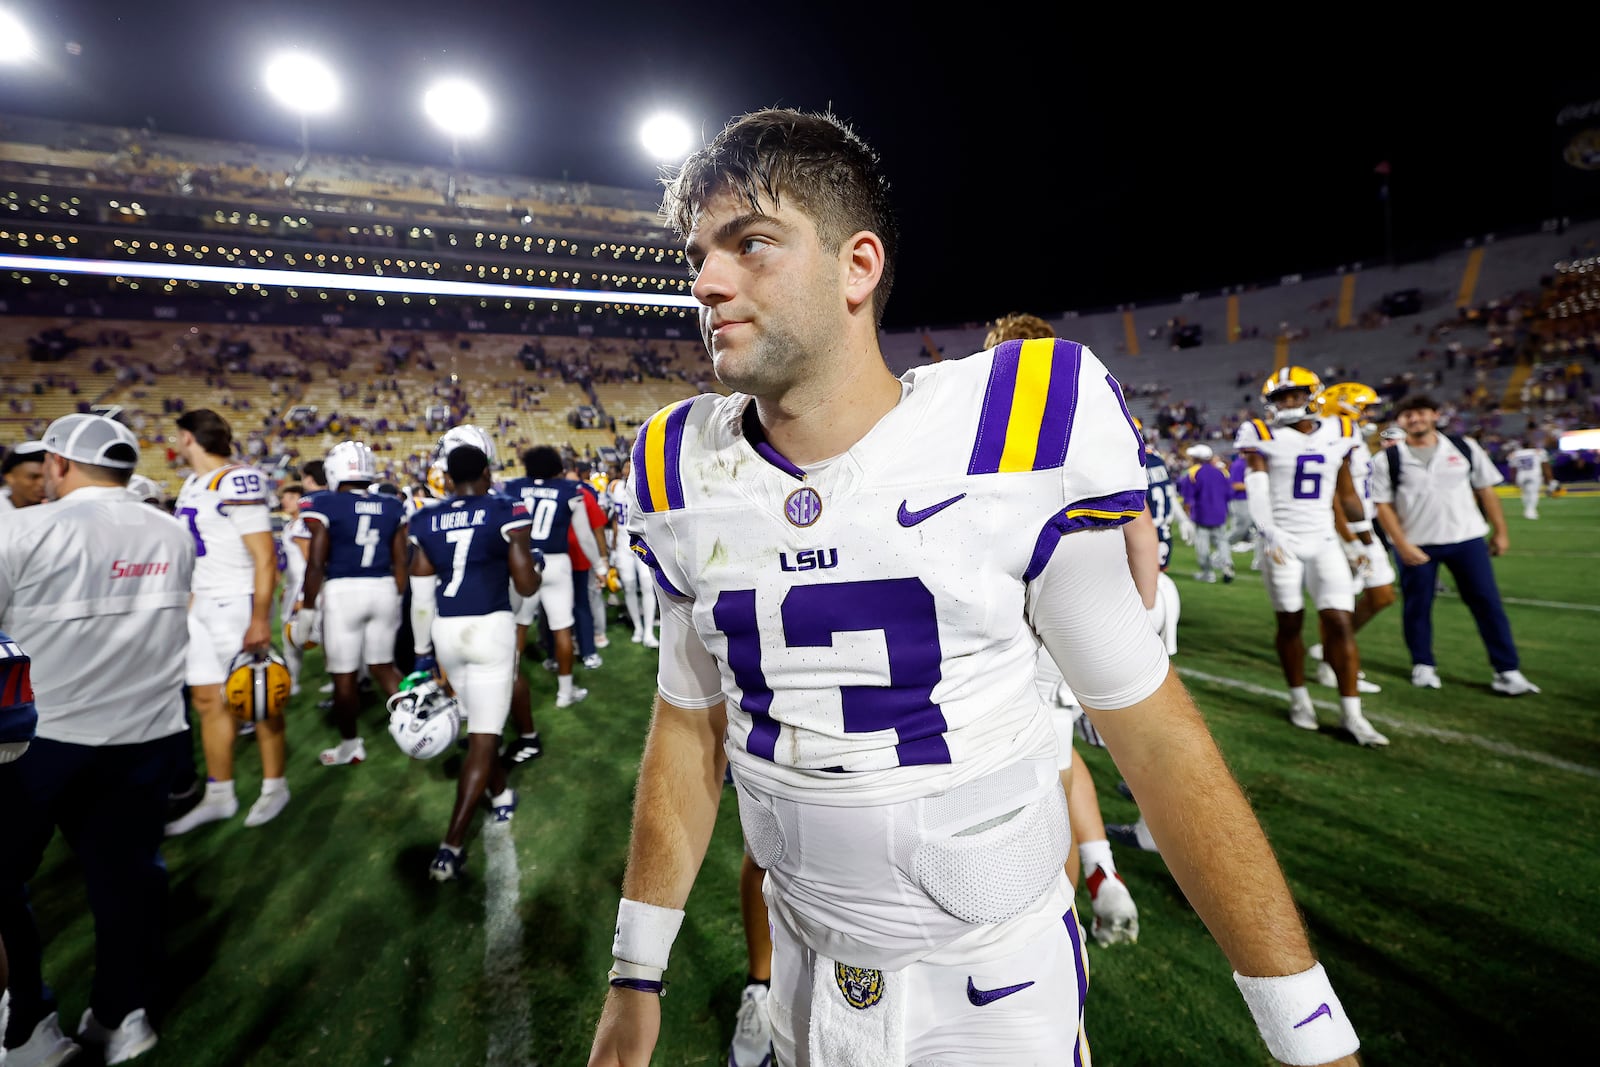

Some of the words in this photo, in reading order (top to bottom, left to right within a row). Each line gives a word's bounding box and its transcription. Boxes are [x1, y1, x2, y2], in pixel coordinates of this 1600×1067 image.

[232, 474, 260, 494] 99
[1293, 454, 1325, 499] 6
[788, 490, 819, 524] SEC
[355, 515, 381, 567] 4
[443, 527, 475, 597] 7
[779, 547, 839, 572] LSU
[713, 577, 952, 767] 13
